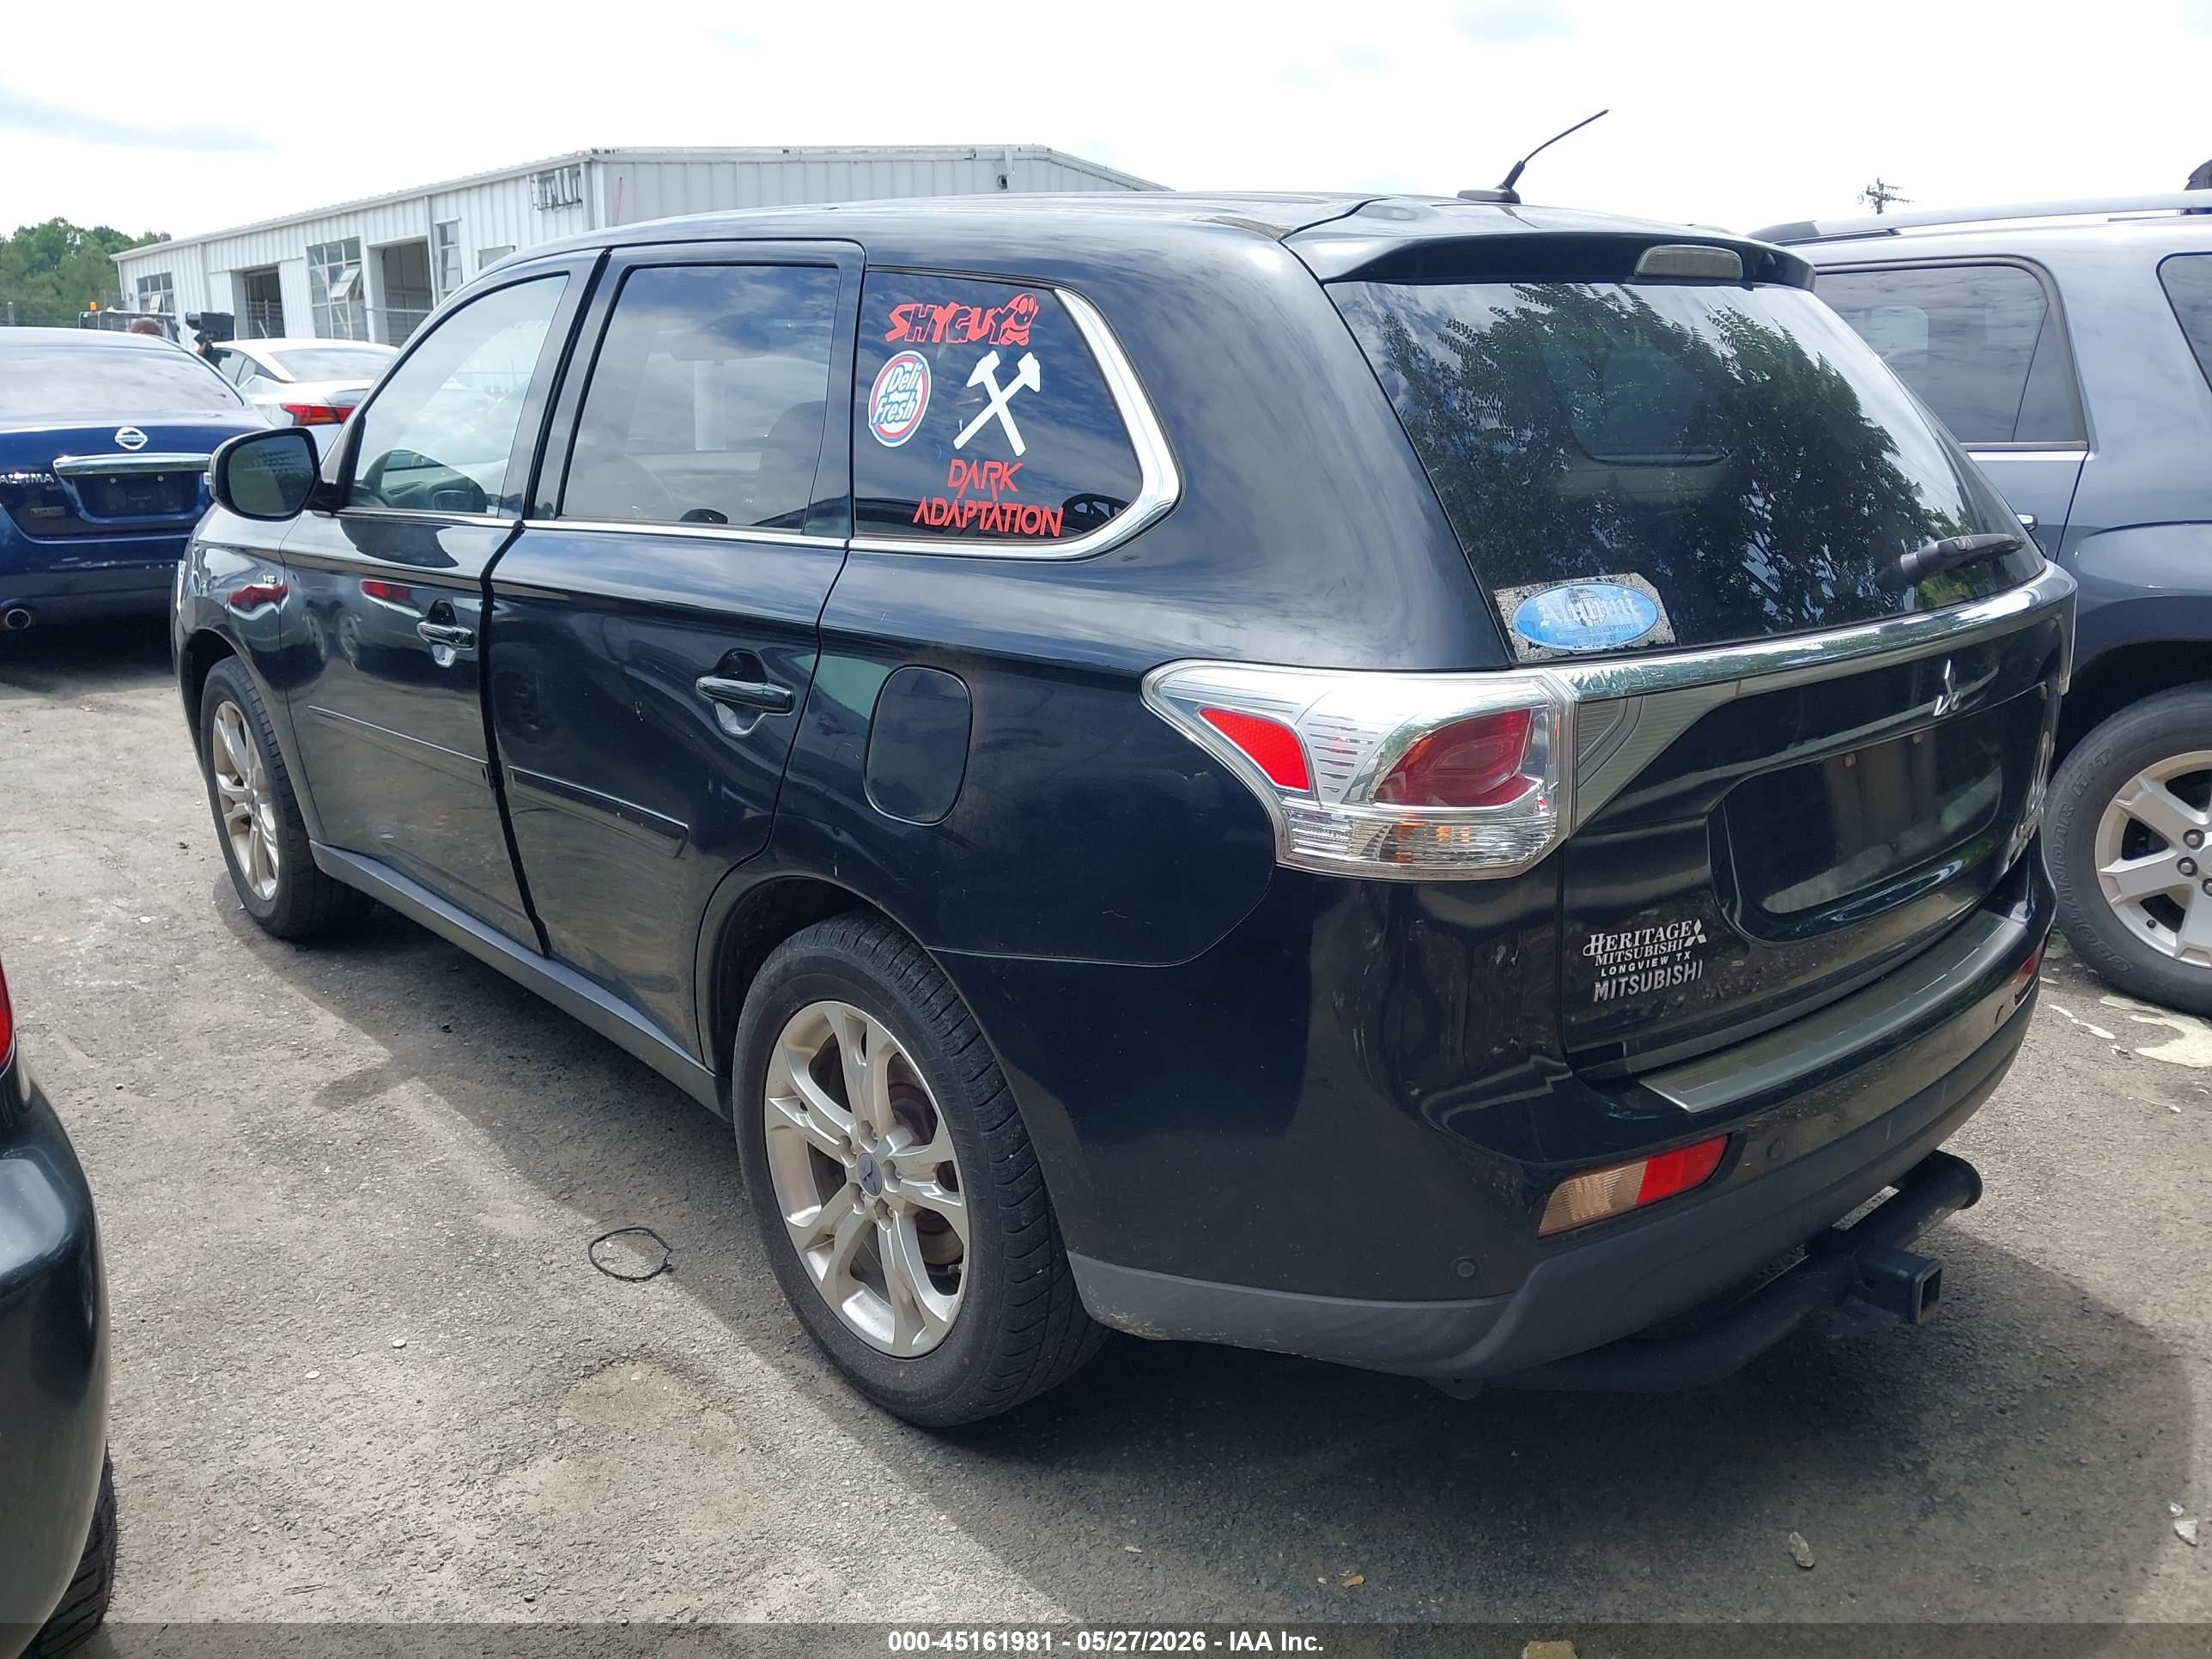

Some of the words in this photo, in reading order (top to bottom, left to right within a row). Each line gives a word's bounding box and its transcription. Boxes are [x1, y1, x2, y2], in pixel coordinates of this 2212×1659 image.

[887, 363, 923, 394] Deli
[872, 394, 919, 425] Fresh
[0, 473, 54, 484] ALTIMA
[947, 459, 1024, 501] DARK
[913, 495, 1065, 537] ADAPTATION
[1582, 920, 1692, 957] HERITAGE
[1595, 939, 1685, 967] MITSUBISHI
[1601, 955, 1669, 977] LONGVIEW
[1675, 951, 1692, 962] TX
[1593, 959, 1704, 1002] MITSUBISHI
